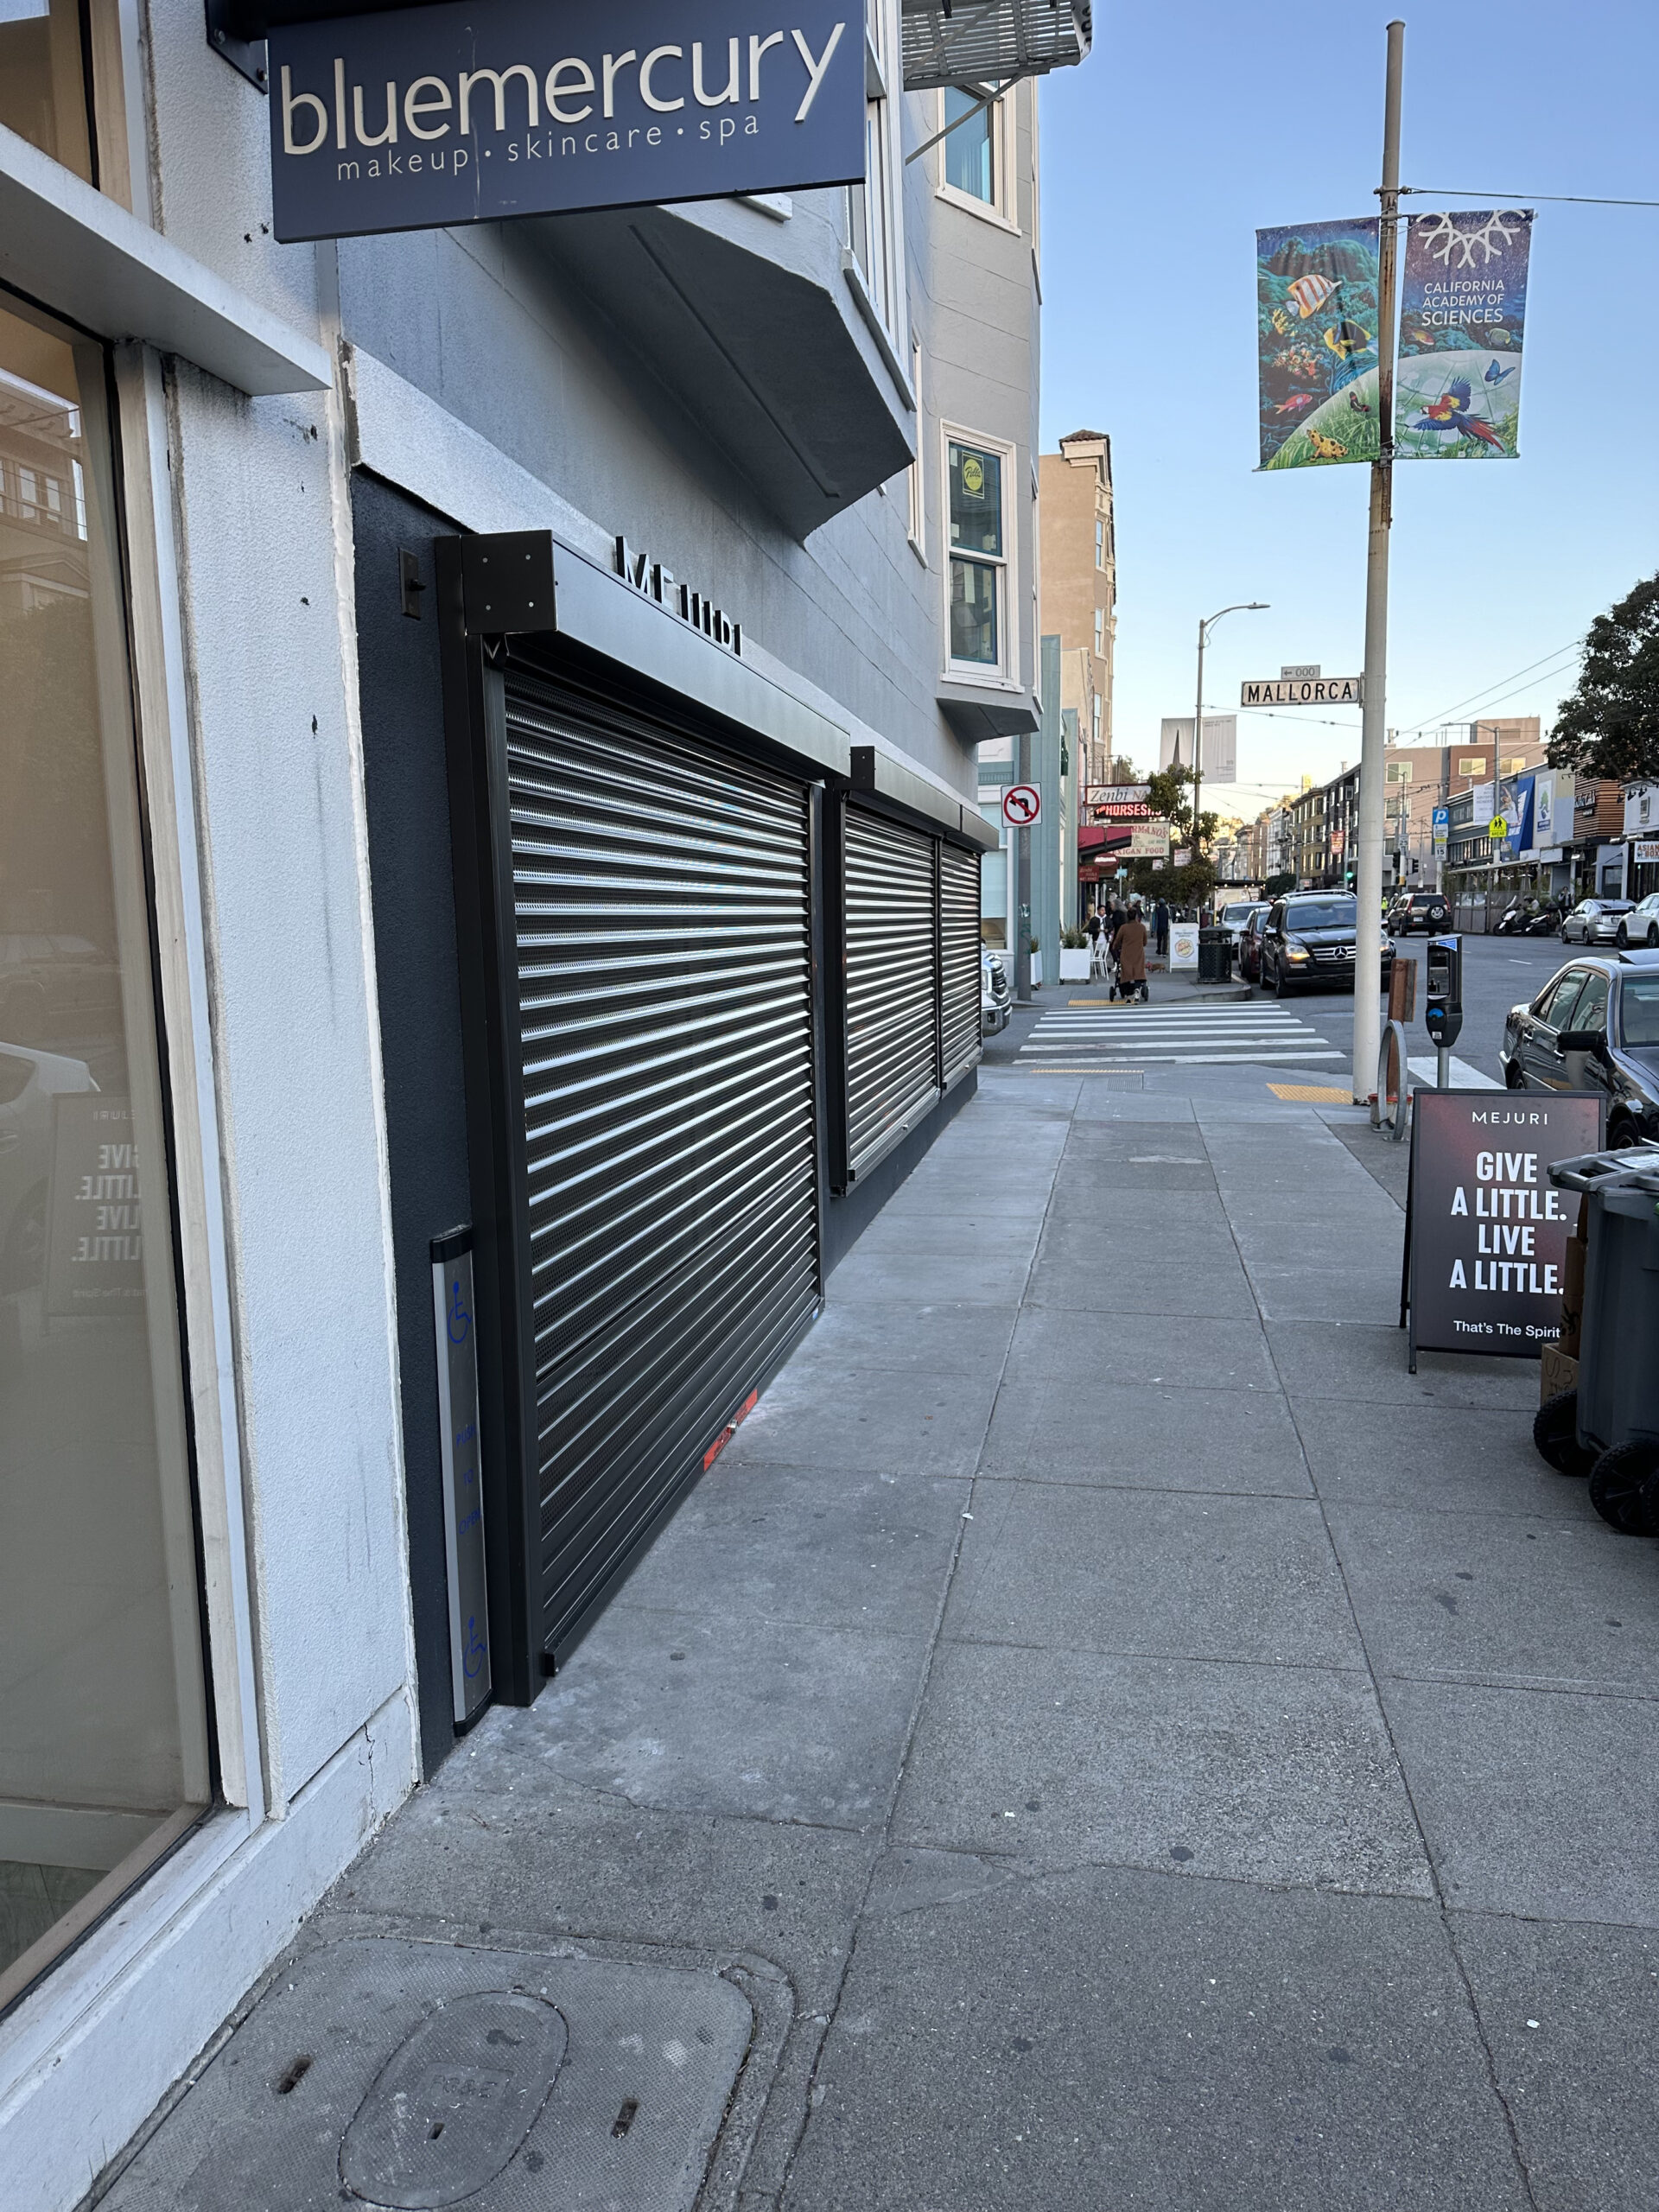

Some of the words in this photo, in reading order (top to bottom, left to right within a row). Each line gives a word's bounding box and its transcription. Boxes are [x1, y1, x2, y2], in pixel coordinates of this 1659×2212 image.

[280, 22, 846, 156] bluemercury
[337, 143, 469, 180] makeup
[508, 126, 663, 162] skincare
[699, 113, 759, 146] spa
[1424, 279, 1505, 294] CALIFORNIA
[1422, 296, 1484, 308] ACADEMY
[1487, 294, 1505, 305] OF
[1421, 308, 1503, 327] SCIENCES
[1296, 667, 1315, 677] 000
[1248, 682, 1352, 702] MALLORCA
[1090, 787, 1128, 803] Zenbi
[1105, 804, 1163, 816] HORSES
[1471, 1111, 1548, 1125] MEJURI
[1476, 1152, 1538, 1183] GIVE
[1450, 1186, 1468, 1216] A
[1476, 1187, 1567, 1220] LITTLE.
[1478, 1224, 1535, 1255] LIVE
[1449, 1259, 1467, 1288] A
[1475, 1260, 1564, 1294] LITTLE.
[1453, 1320, 1493, 1334] That's
[1497, 1323, 1522, 1336] The
[1525, 1325, 1560, 1338] Spirit
